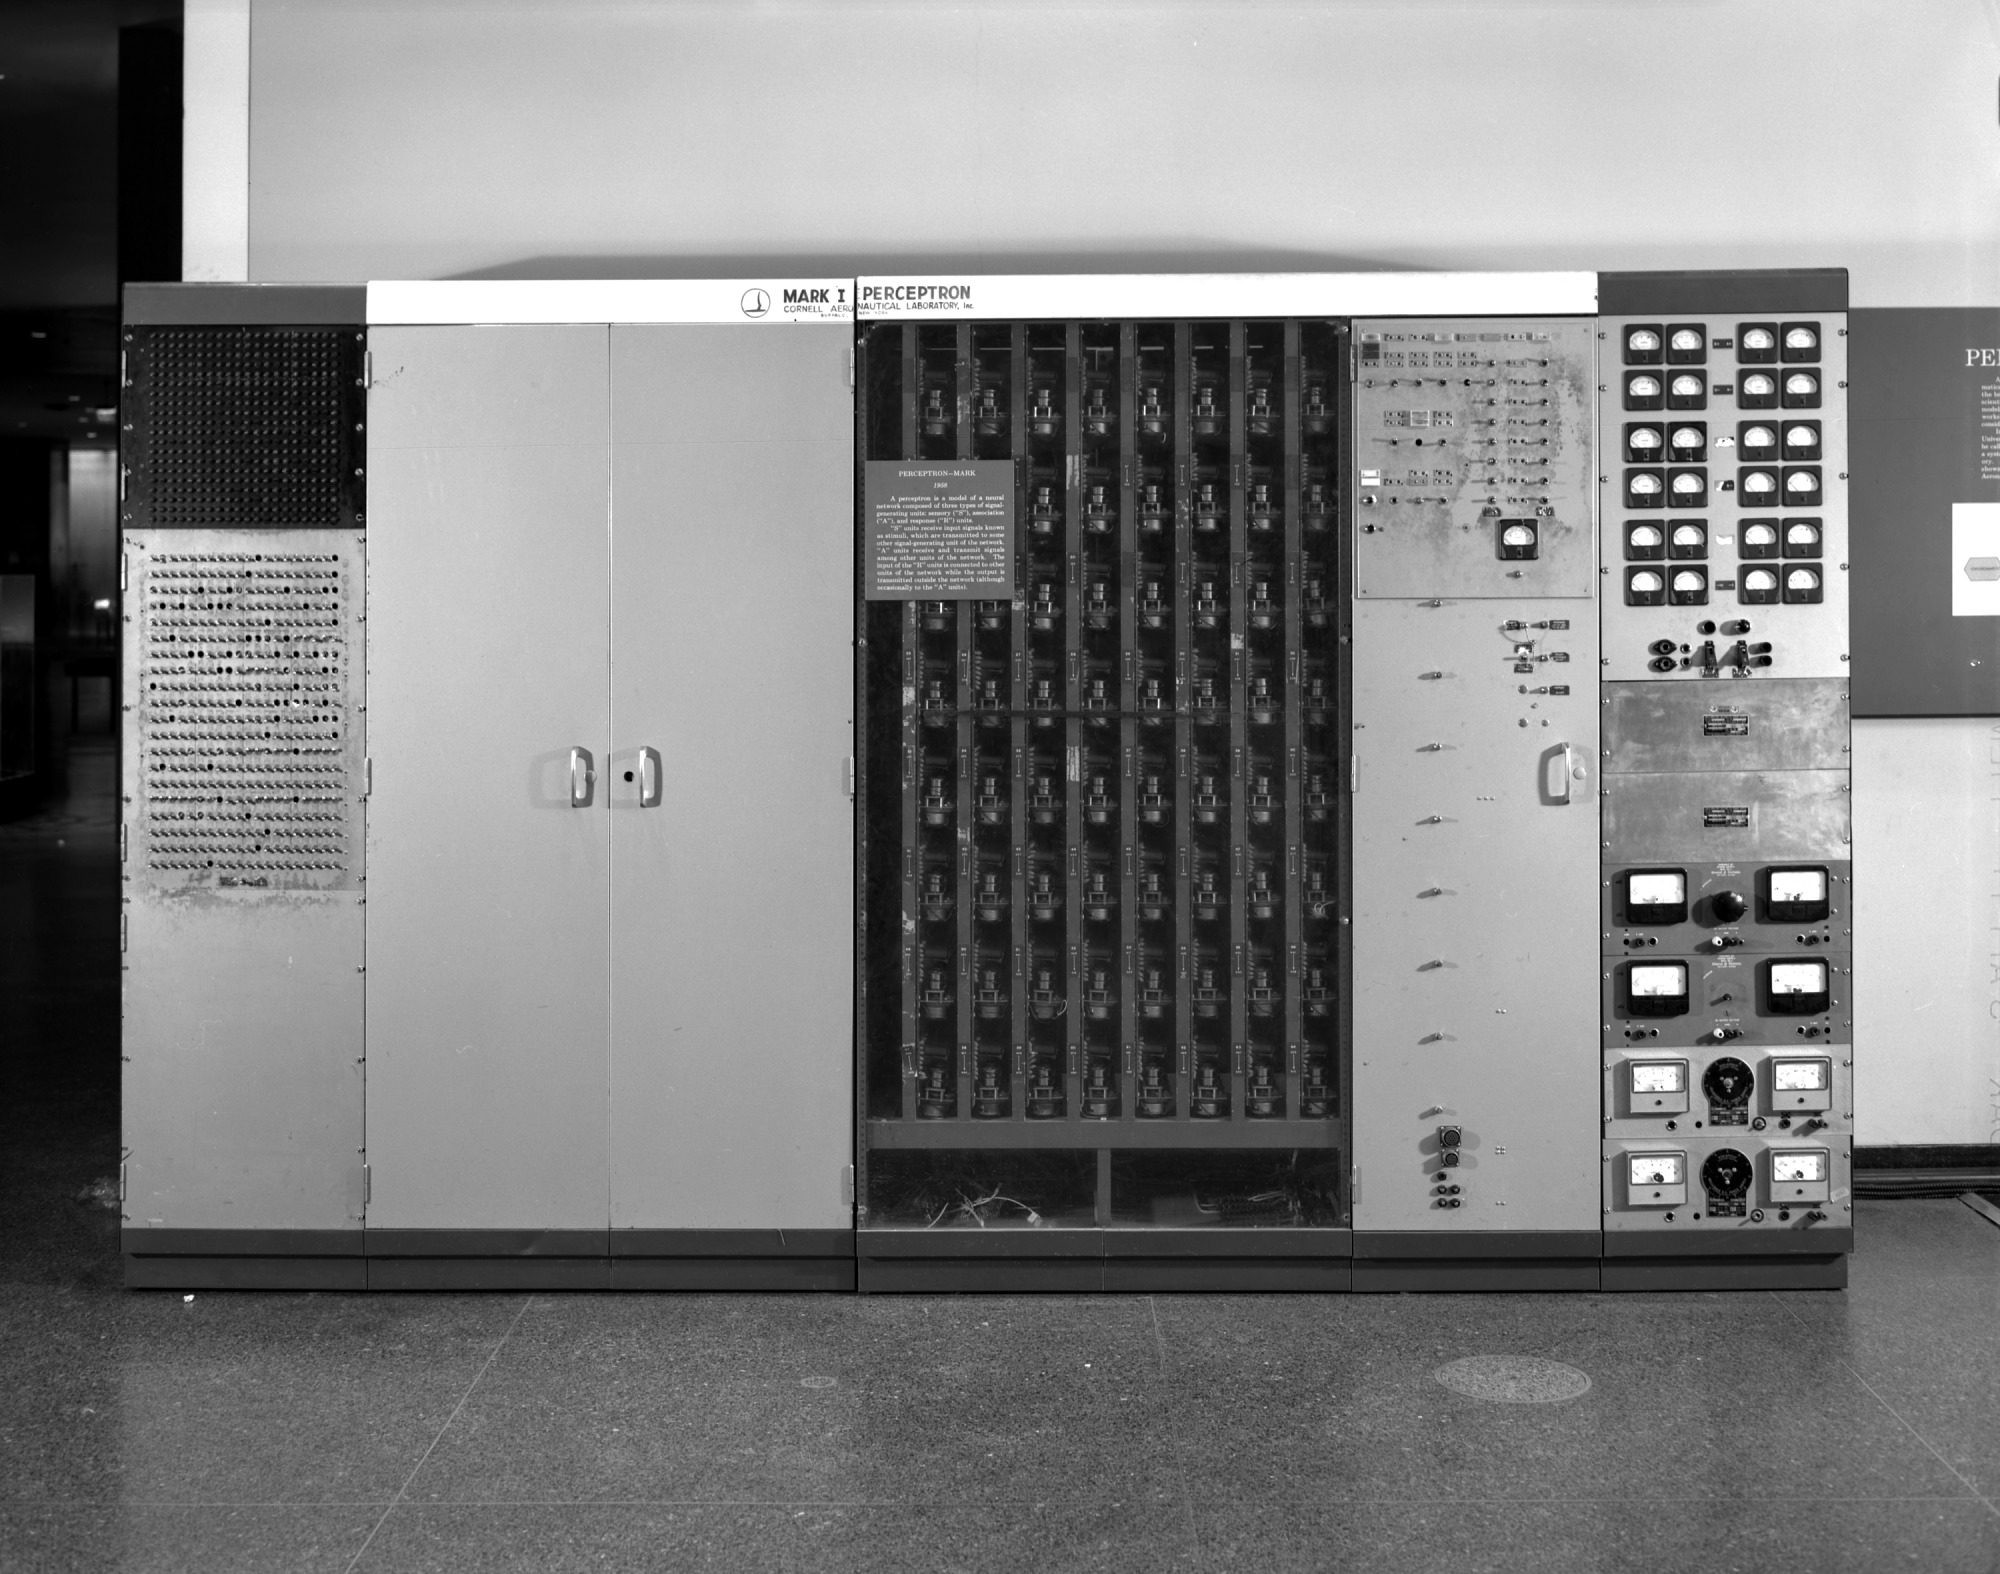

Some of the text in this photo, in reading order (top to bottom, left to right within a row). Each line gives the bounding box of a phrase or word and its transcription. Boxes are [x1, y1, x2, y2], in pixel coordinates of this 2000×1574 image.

[783, 285, 971, 303] MARK I PERCEPTRON
[783, 305, 823, 313] CORNELL
[906, 301, 960, 310] LABORATORY,
[963, 524, 983, 532] signals
[885, 532, 908, 540] stimuli,
[984, 546, 1005, 554] signals
